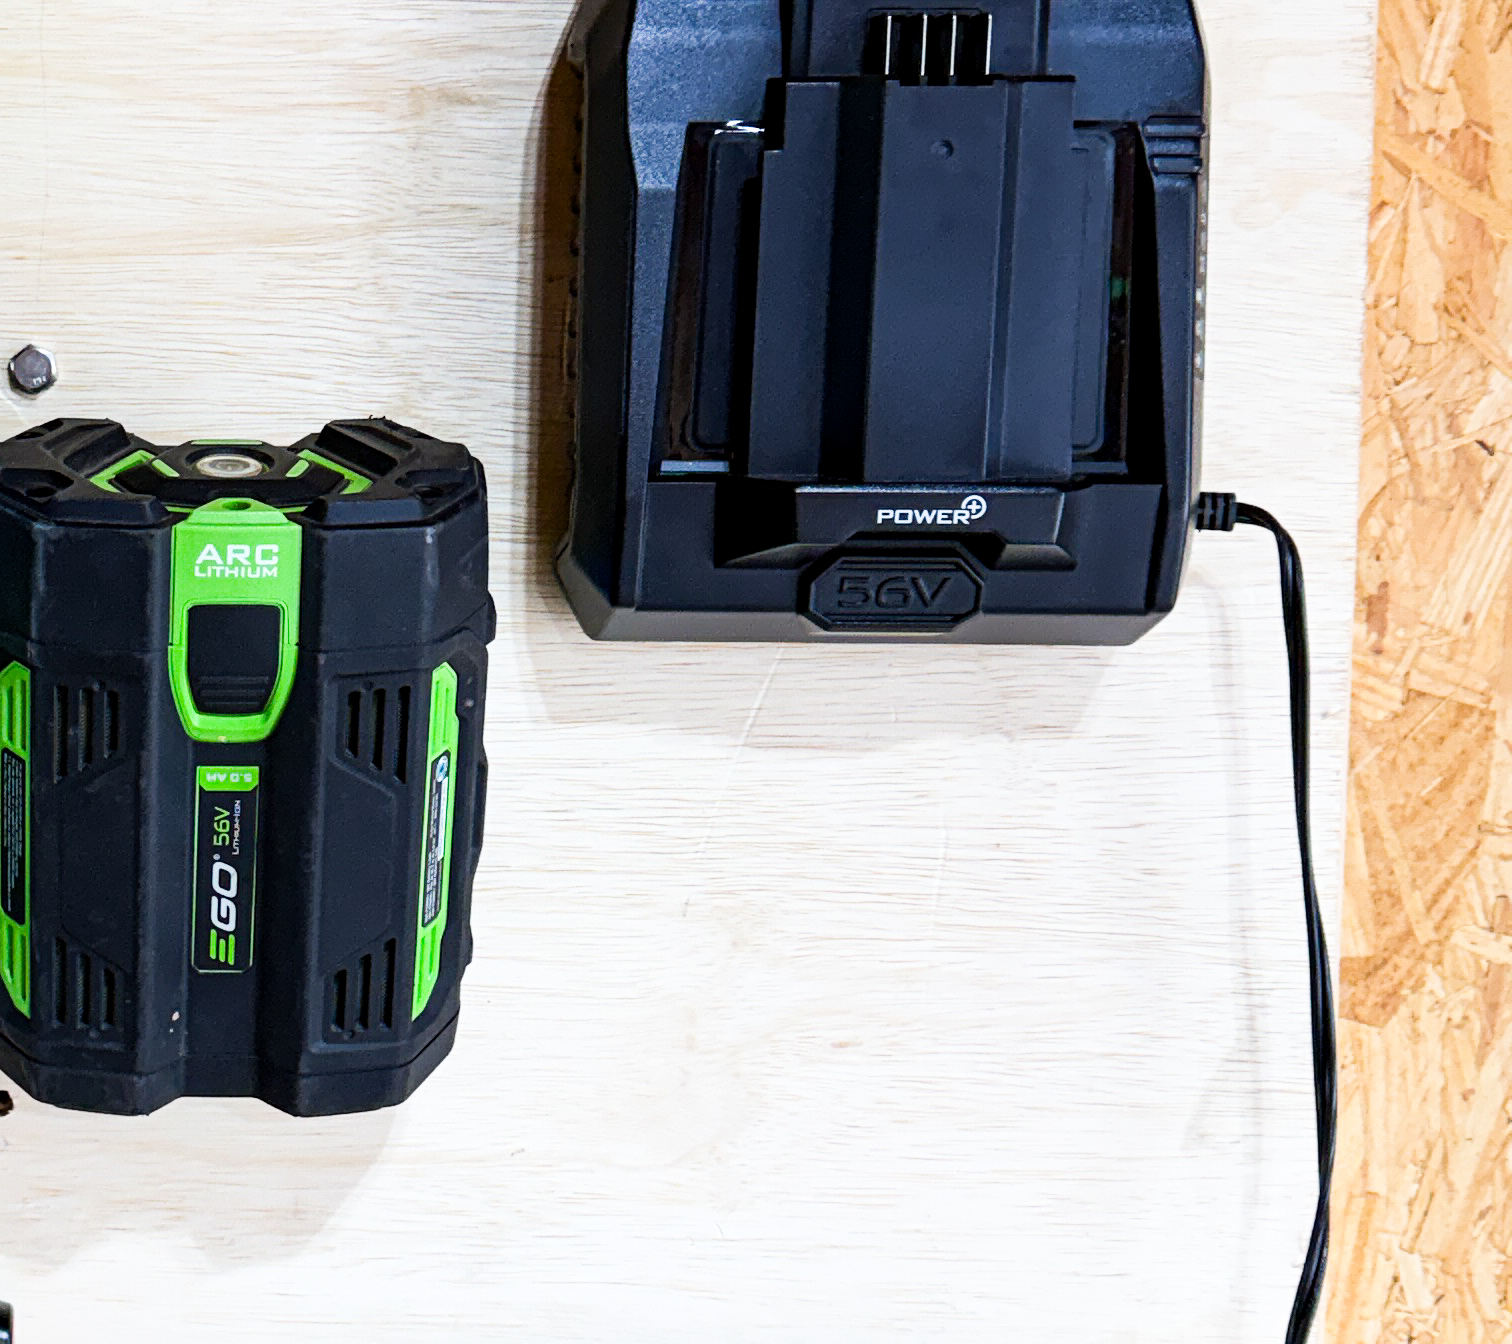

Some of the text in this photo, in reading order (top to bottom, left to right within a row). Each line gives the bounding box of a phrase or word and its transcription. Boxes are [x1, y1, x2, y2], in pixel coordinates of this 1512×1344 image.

[196, 544, 279, 565] ARC
[194, 565, 279, 578] LITHIUM
[836, 576, 952, 609] 56V
[213, 806, 230, 847] 56V
